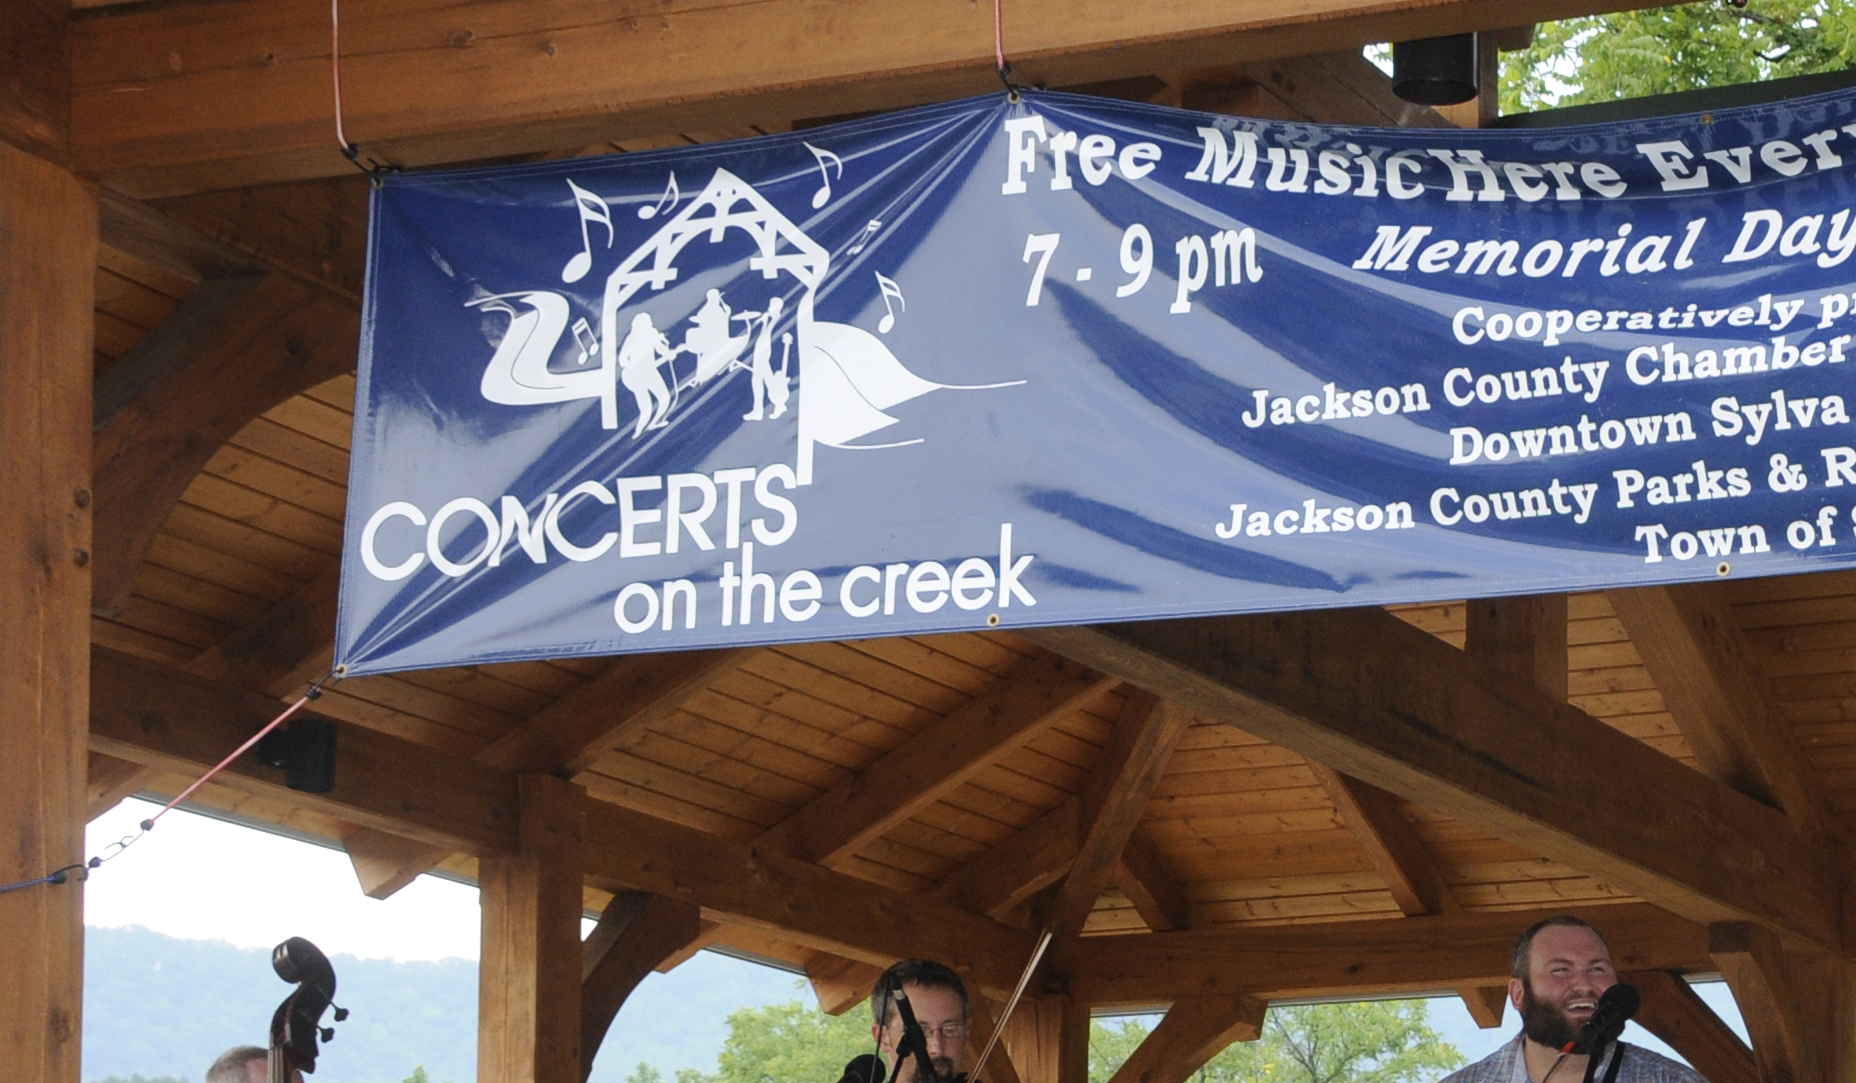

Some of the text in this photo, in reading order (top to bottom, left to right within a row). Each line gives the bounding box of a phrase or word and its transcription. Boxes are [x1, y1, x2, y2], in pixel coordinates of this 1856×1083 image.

[1002, 115, 1161, 195] Free
[1185, 126, 1424, 199] Music
[1429, 150, 1626, 201] Here
[1022, 224, 1263, 314] 7 - 9 pm
[1353, 218, 1706, 277] Memorial
[1453, 294, 1805, 346] Cooperatively
[1242, 382, 1430, 427] Jackson
[1444, 357, 1609, 406] County
[1626, 335, 1851, 385] Chamber
[1450, 412, 1696, 465] Downtown
[1712, 390, 1849, 445] Sylva
[360, 462, 798, 581] CONCERTS
[1215, 498, 1415, 539] Jackson
[1431, 479, 1598, 525] County
[1613, 460, 1751, 508] Parks
[1769, 454, 1807, 492] &
[1635, 524, 1768, 563] Town
[1795, 503, 1837, 549] of
[614, 523, 1037, 634] on the creek
